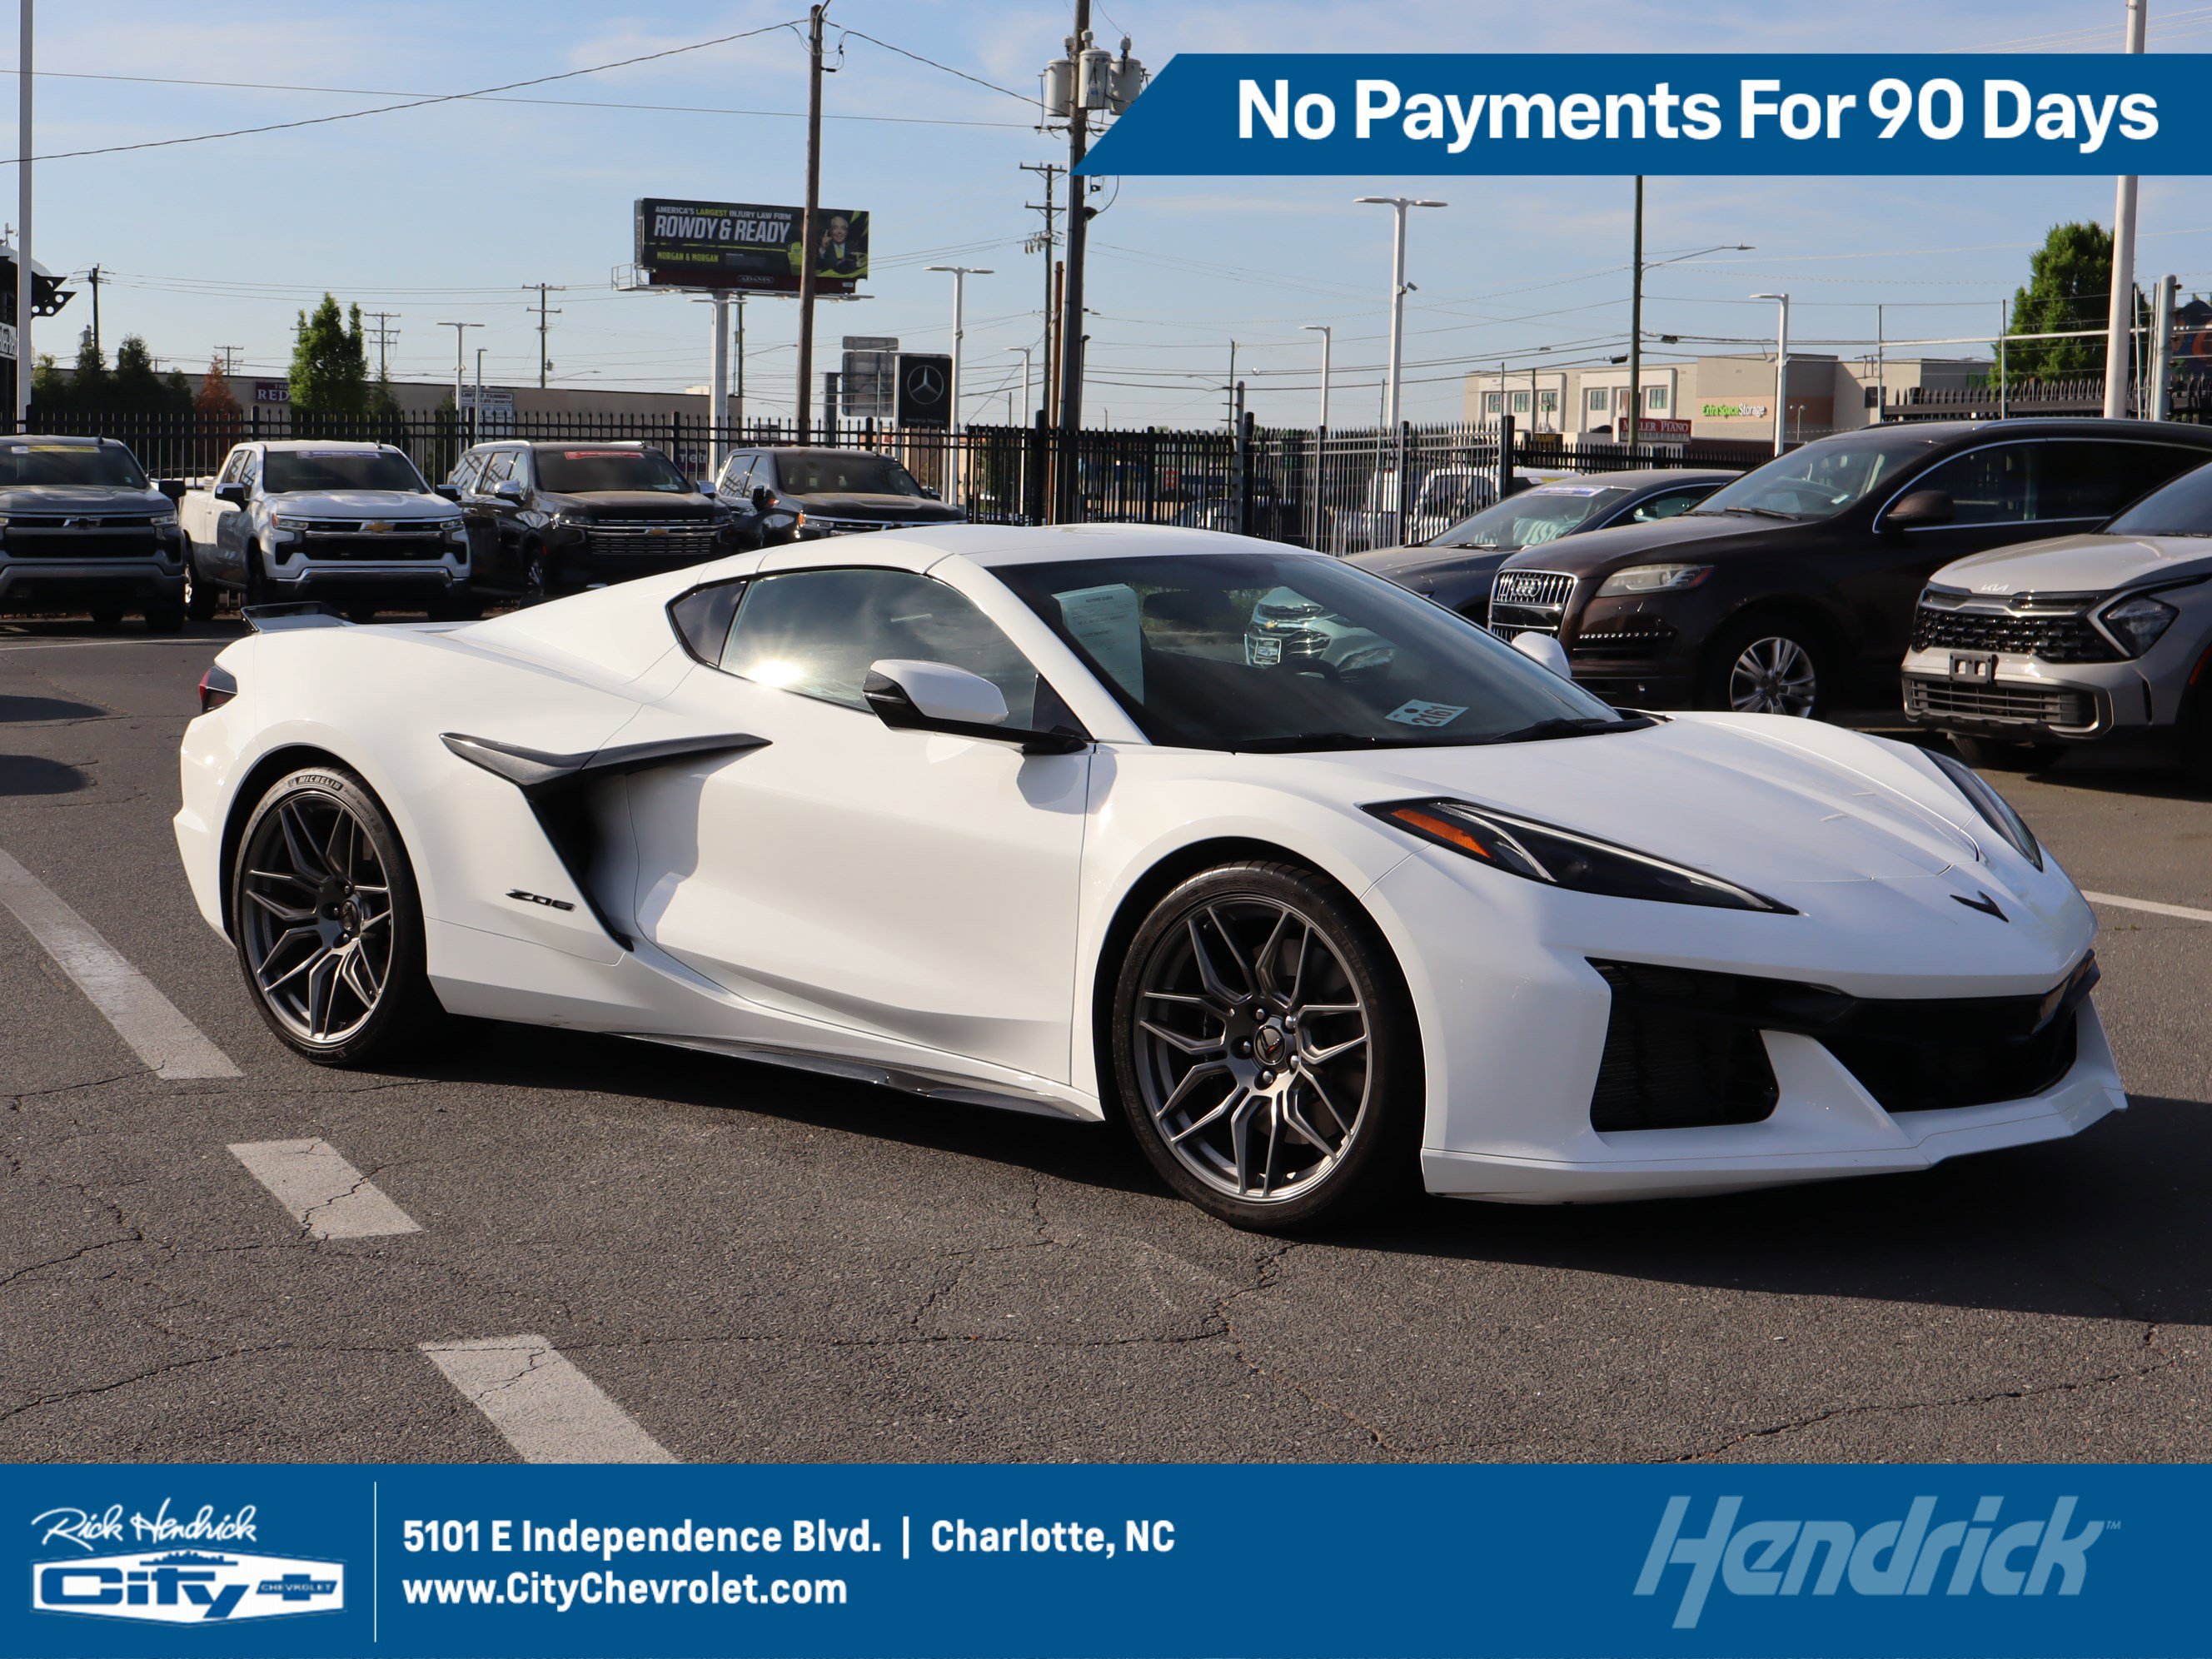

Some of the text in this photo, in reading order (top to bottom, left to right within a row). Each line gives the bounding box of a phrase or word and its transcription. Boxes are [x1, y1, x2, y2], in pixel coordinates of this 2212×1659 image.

[655, 207, 695, 215] AMERICA'S
[695, 208, 727, 217] LARGEST
[730, 210, 755, 218] INJURY
[774, 212, 791, 221] FIRM
[654, 215, 791, 244] ROWDY & READY
[656, 252, 685, 261] MORGAN
[685, 253, 690, 262] &
[691, 253, 719, 262] MORGAN
[1661, 420, 1689, 432] PIANO
[1412, 705, 1458, 725] 2161
[298, 775, 342, 790] MICHELIN
[505, 889, 576, 913] Z06
